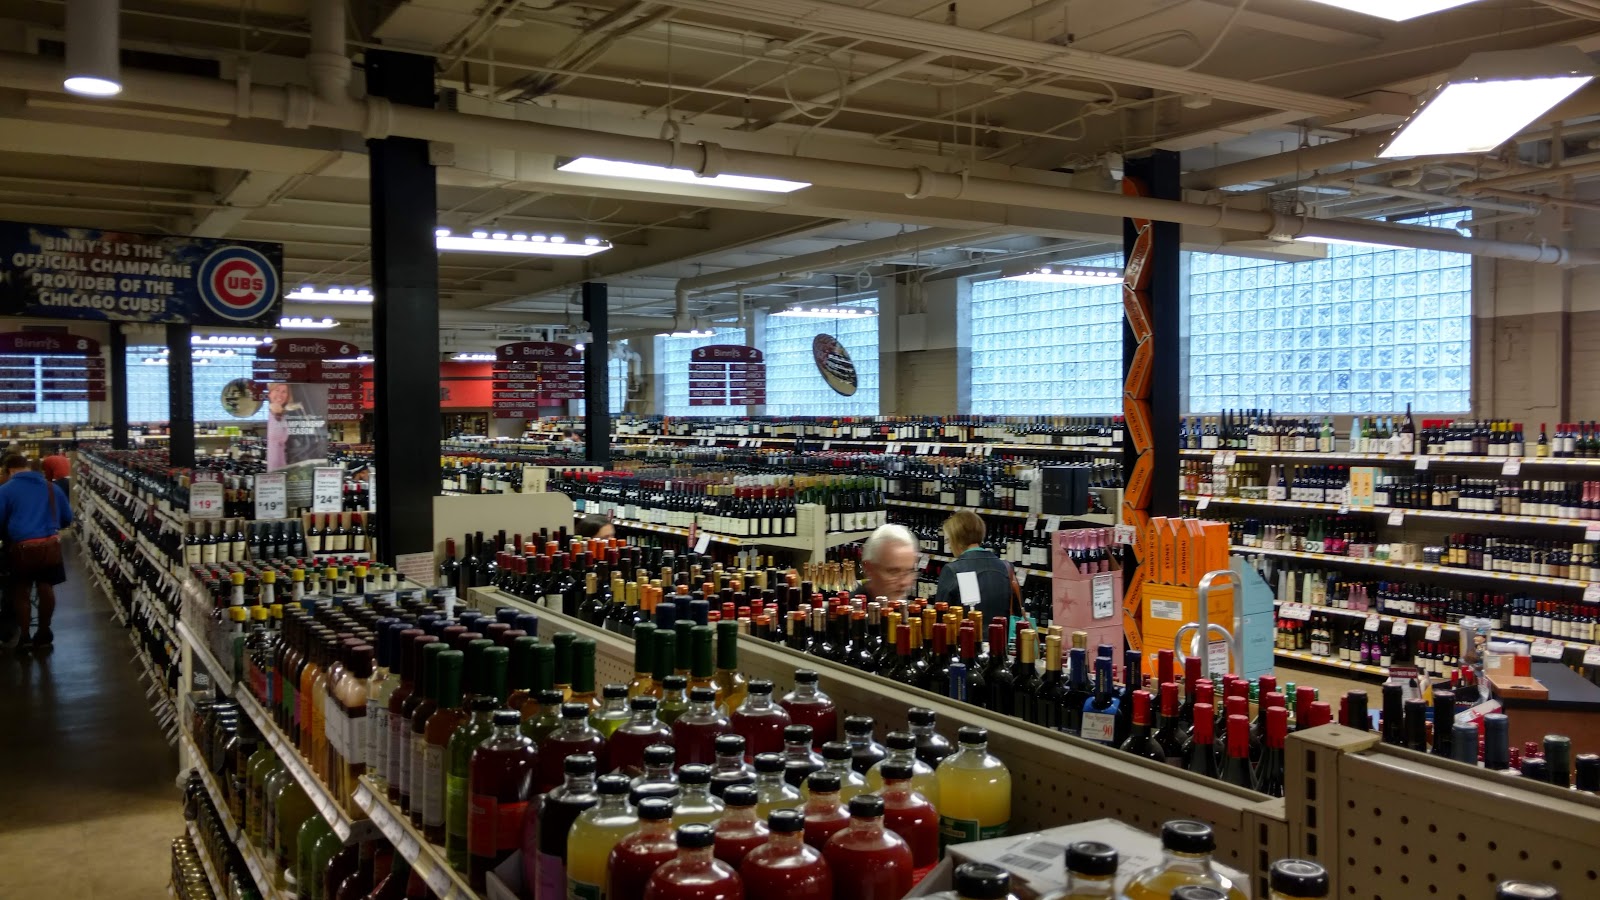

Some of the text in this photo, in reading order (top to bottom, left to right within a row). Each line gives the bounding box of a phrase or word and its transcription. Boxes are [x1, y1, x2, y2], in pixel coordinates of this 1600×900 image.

[43, 237, 163, 260] BINNY'S IS THE
[11, 252, 193, 279] OFFICIAL CHAMPAGNE
[31, 272, 175, 295] PROVIDER OF THE
[38, 291, 167, 313] CHICAGO CUBS!
[14, 337, 89, 350] Binny's 8
[268, 342, 350, 355] 7 Binny's 6
[505, 346, 573, 357] 5 Binny's 4
[698, 349, 707, 358] 3
[749, 349, 757, 358] 2
[287, 427, 315, 435] SEASON
[195, 472, 219, 482] SALE
[1129, 572, 1146, 606] STOCKHOLM
[1102, 724, 1113, 737] 90
